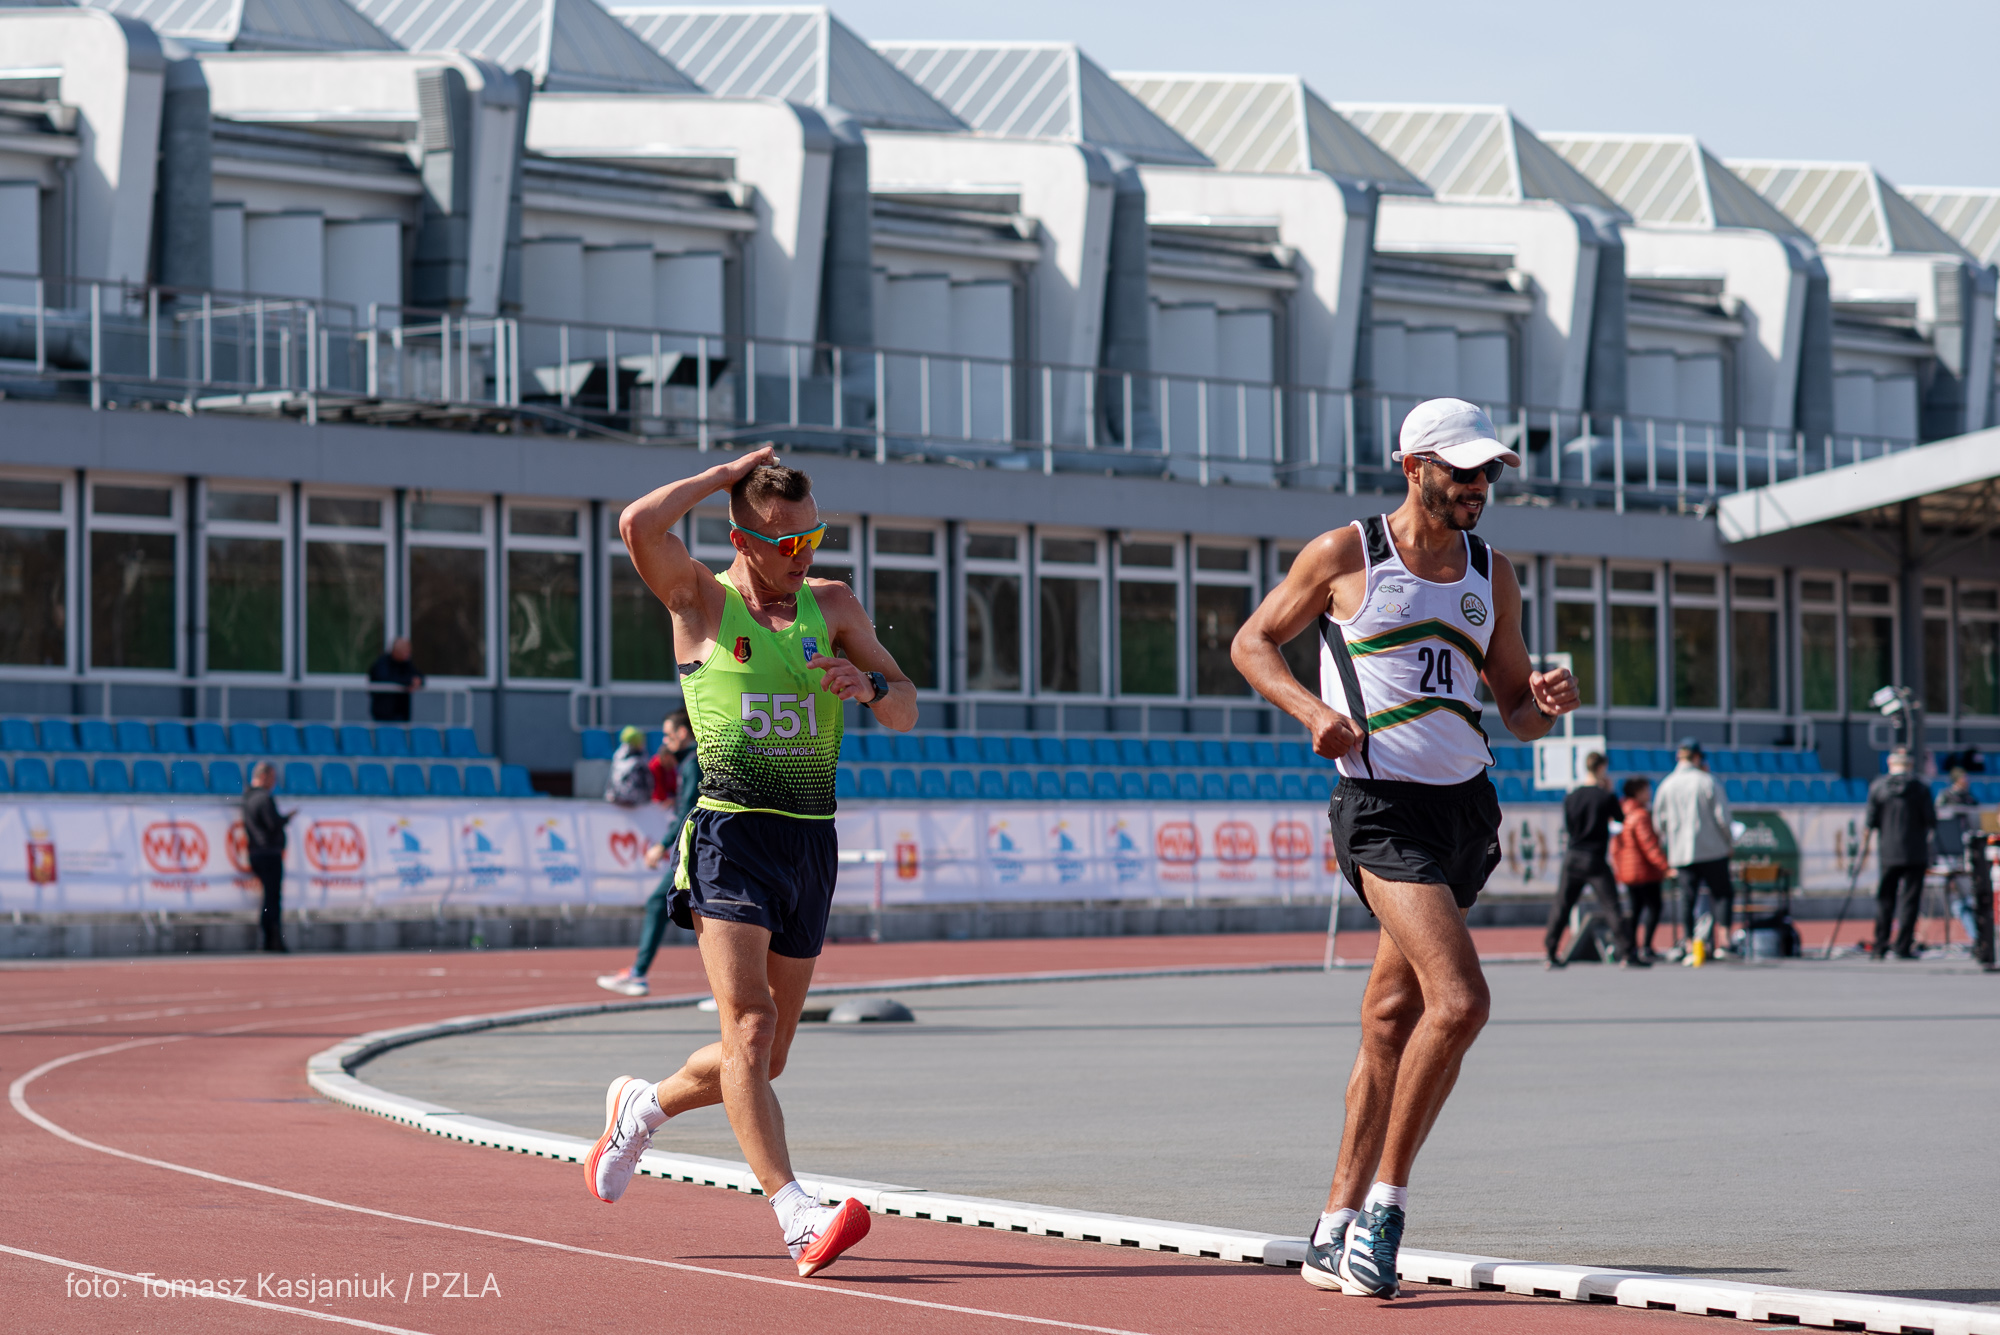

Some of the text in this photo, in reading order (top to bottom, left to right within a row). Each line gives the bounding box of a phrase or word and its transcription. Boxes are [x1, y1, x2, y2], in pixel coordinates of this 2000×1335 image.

[1465, 597, 1483, 612] RKS
[1418, 647, 1454, 694] 24
[740, 692, 818, 739] 551
[746, 745, 816, 756] STALOWA WOLA
